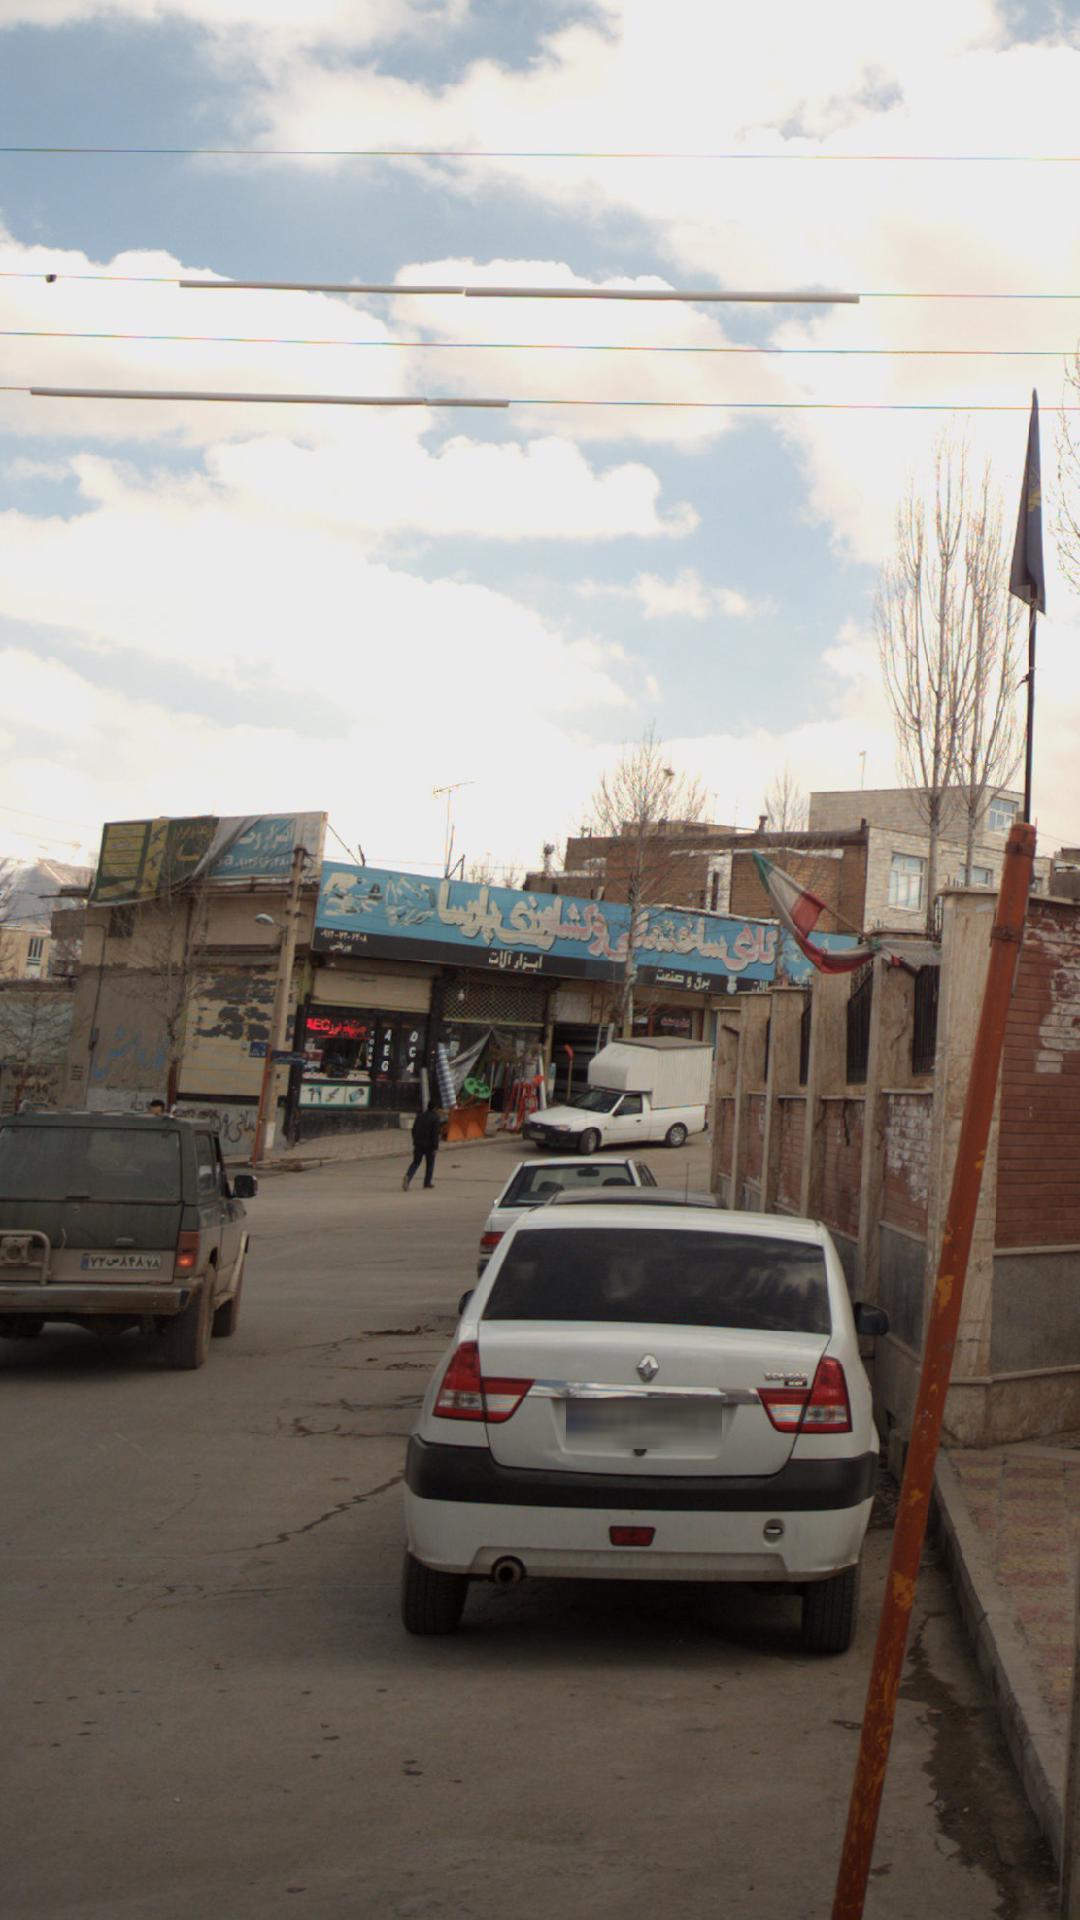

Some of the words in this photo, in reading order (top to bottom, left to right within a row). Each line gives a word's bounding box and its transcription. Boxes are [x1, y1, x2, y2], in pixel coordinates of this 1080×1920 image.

[437, 879, 503, 945] پارسا
[514, 952, 544, 973] ابزار
[656, 969, 685, 984] صنعت
[694, 971, 711, 990] برق
[381, 1028, 392, 1072] AEG
[406, 1030, 419, 1073] DCA
